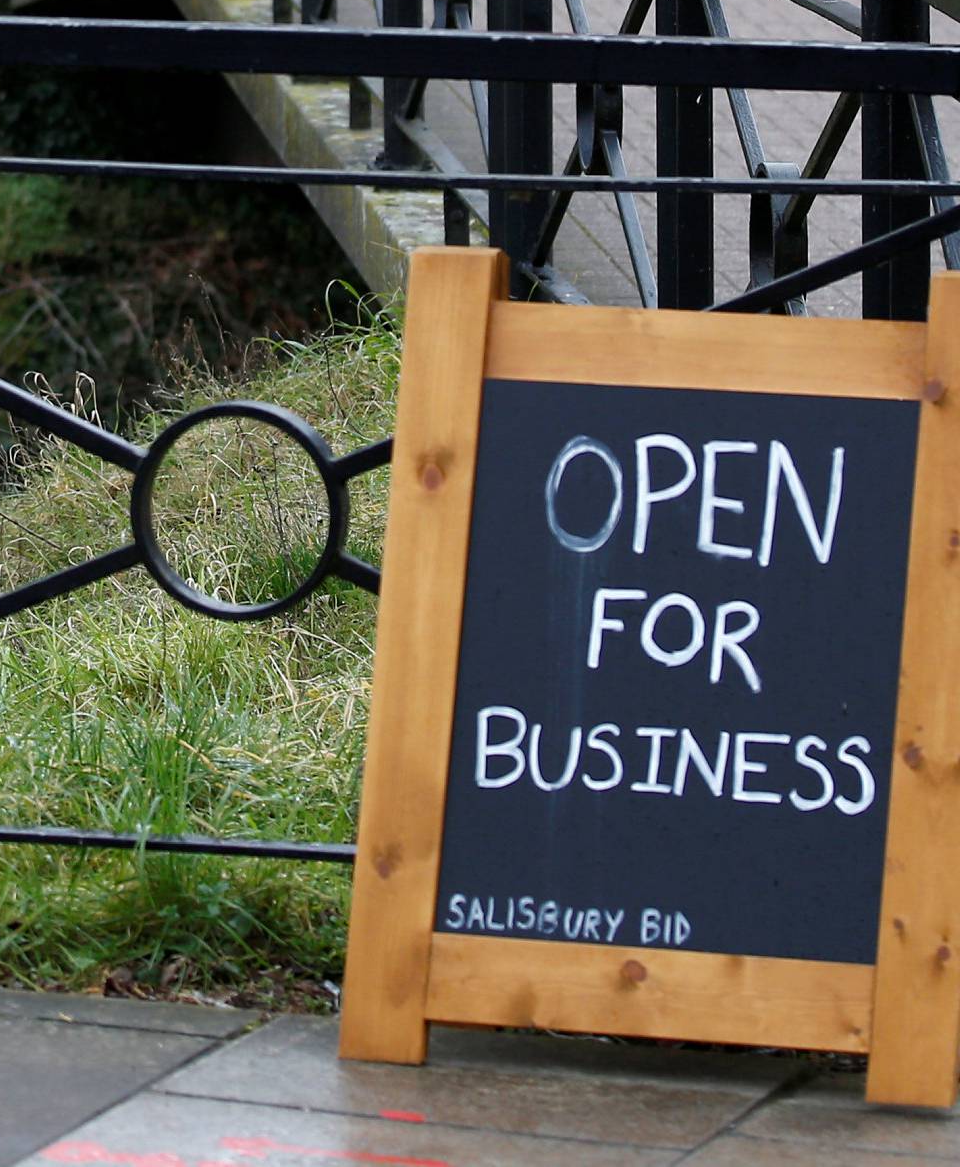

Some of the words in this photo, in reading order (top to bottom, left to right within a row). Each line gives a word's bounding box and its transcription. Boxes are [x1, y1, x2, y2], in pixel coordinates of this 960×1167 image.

[544, 433, 846, 569] OPEN
[586, 587, 763, 694] FOR
[474, 705, 877, 817] BUSINESS
[445, 893, 626, 942] SALISBURY
[640, 907, 693, 946] BID
